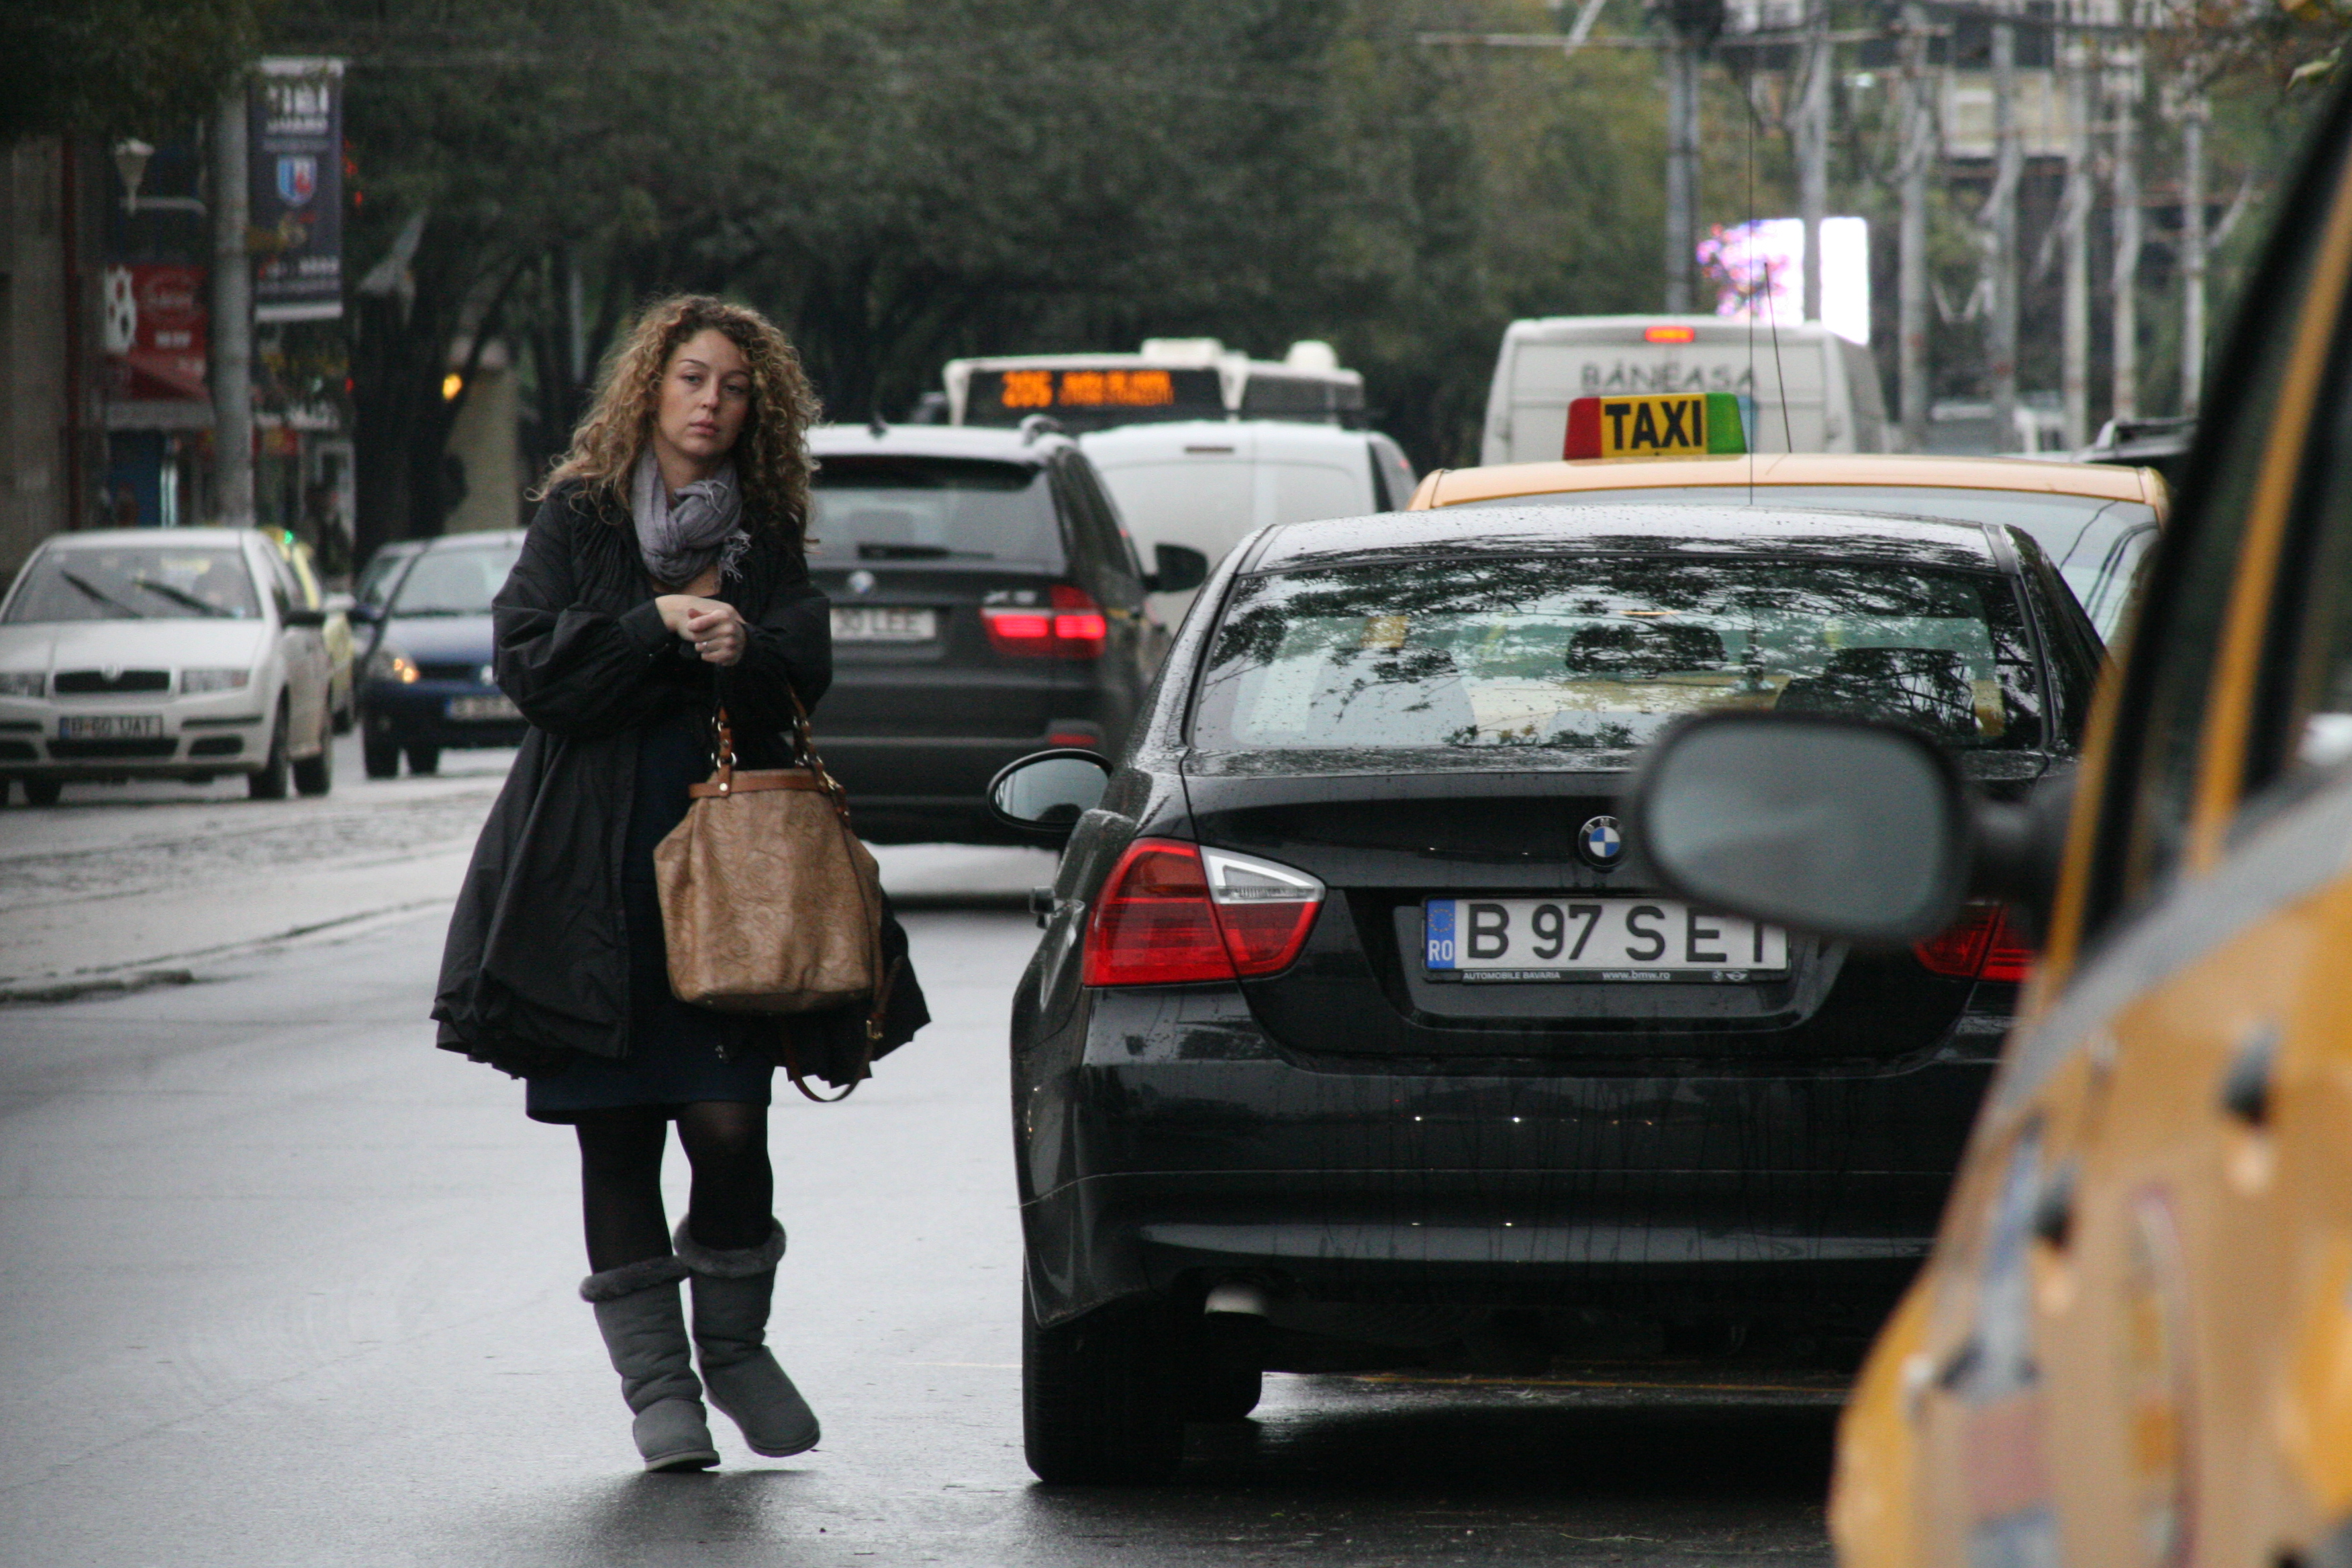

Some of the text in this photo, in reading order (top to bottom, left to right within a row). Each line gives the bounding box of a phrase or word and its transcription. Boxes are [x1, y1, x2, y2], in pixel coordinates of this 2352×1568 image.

[1604, 399, 1703, 450] TAXI
[1467, 903, 1509, 959] B
[1531, 904, 1602, 960] 97
[1428, 939, 1453, 961] RO
[1463, 971, 1671, 981] AUTOMOBILE BAVARIA www.bmw.ro
